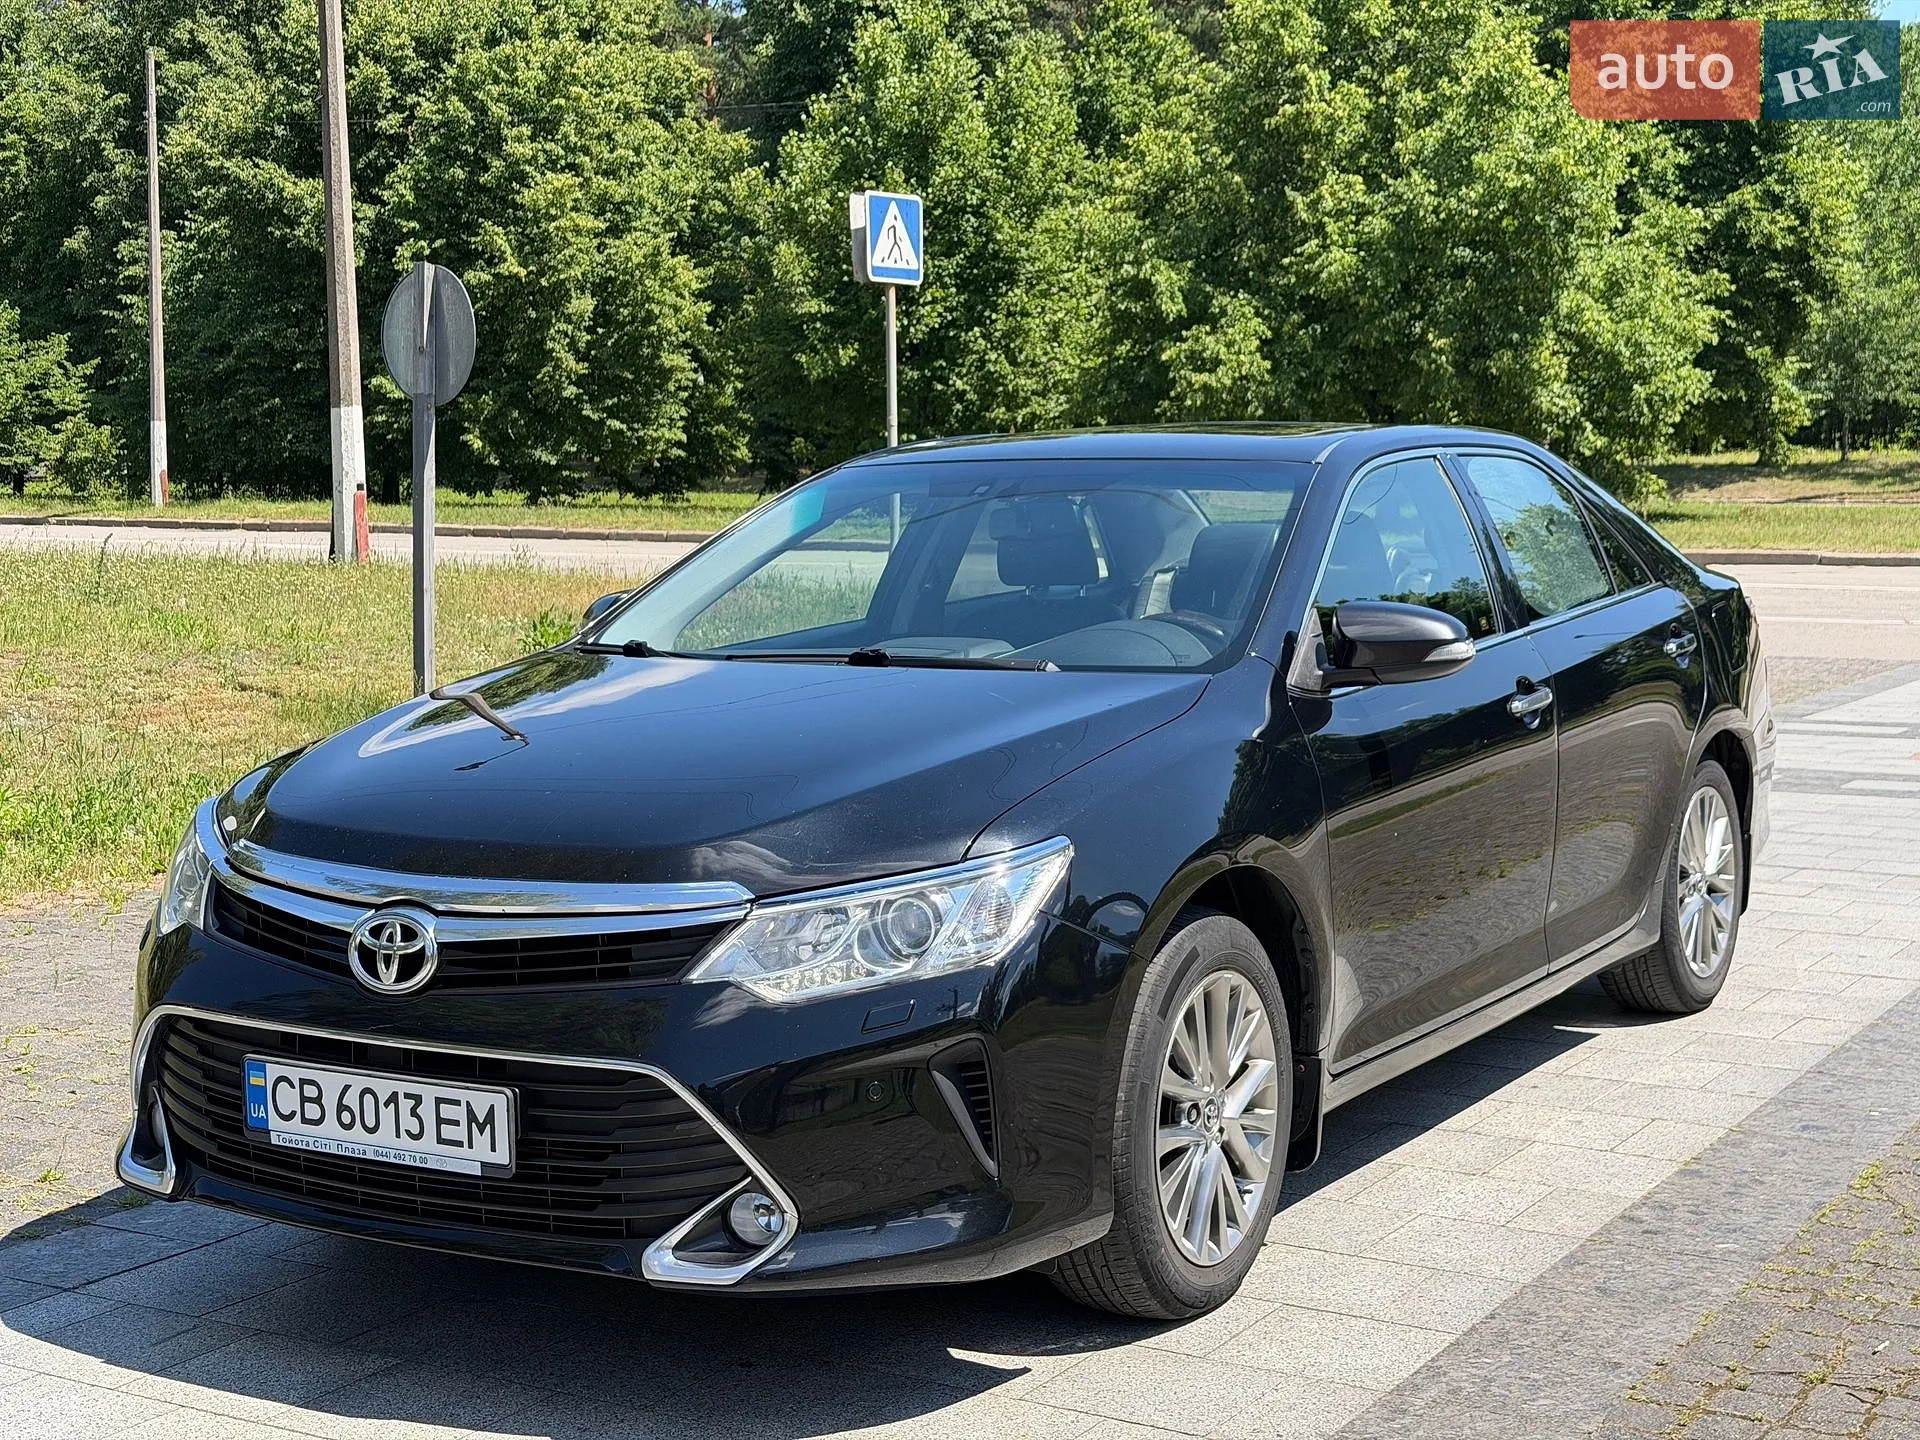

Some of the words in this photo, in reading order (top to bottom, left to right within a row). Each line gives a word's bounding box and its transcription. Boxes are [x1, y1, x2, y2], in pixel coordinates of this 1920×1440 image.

[251, 1103, 267, 1120] UA
[271, 1075, 327, 1127] CB
[336, 1084, 425, 1141] 6013
[435, 1096, 497, 1152] EM
[276, 1134, 310, 1148] Тойота
[336, 1144, 367, 1156] Плаза
[373, 1148, 391, 1160] (044)
[393, 1151, 406, 1162] 492
[409, 1154, 417, 1164] 70
[419, 1155, 428, 1165] 00
